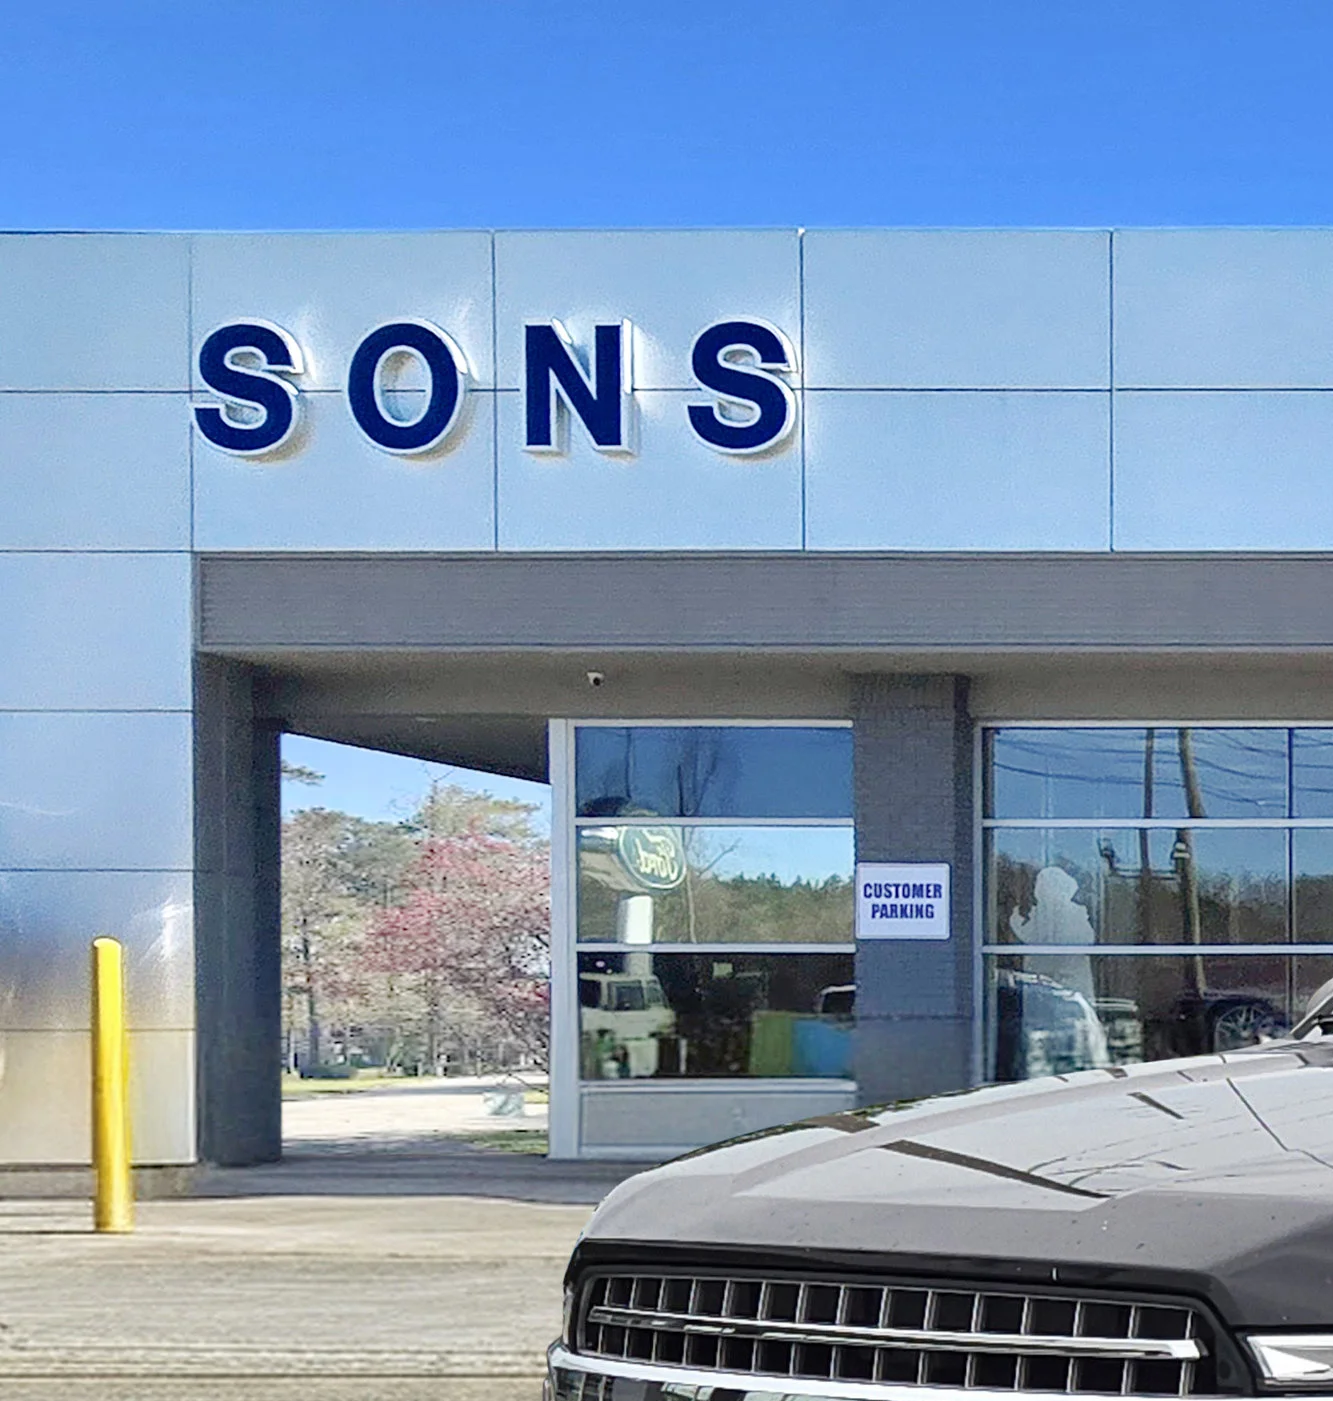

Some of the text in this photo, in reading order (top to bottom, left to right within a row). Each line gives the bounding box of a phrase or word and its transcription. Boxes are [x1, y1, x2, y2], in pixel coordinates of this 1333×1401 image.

[194, 321, 796, 454] SONS
[863, 883, 942, 899] CUSTOMER
[871, 903, 935, 919] PARKING
